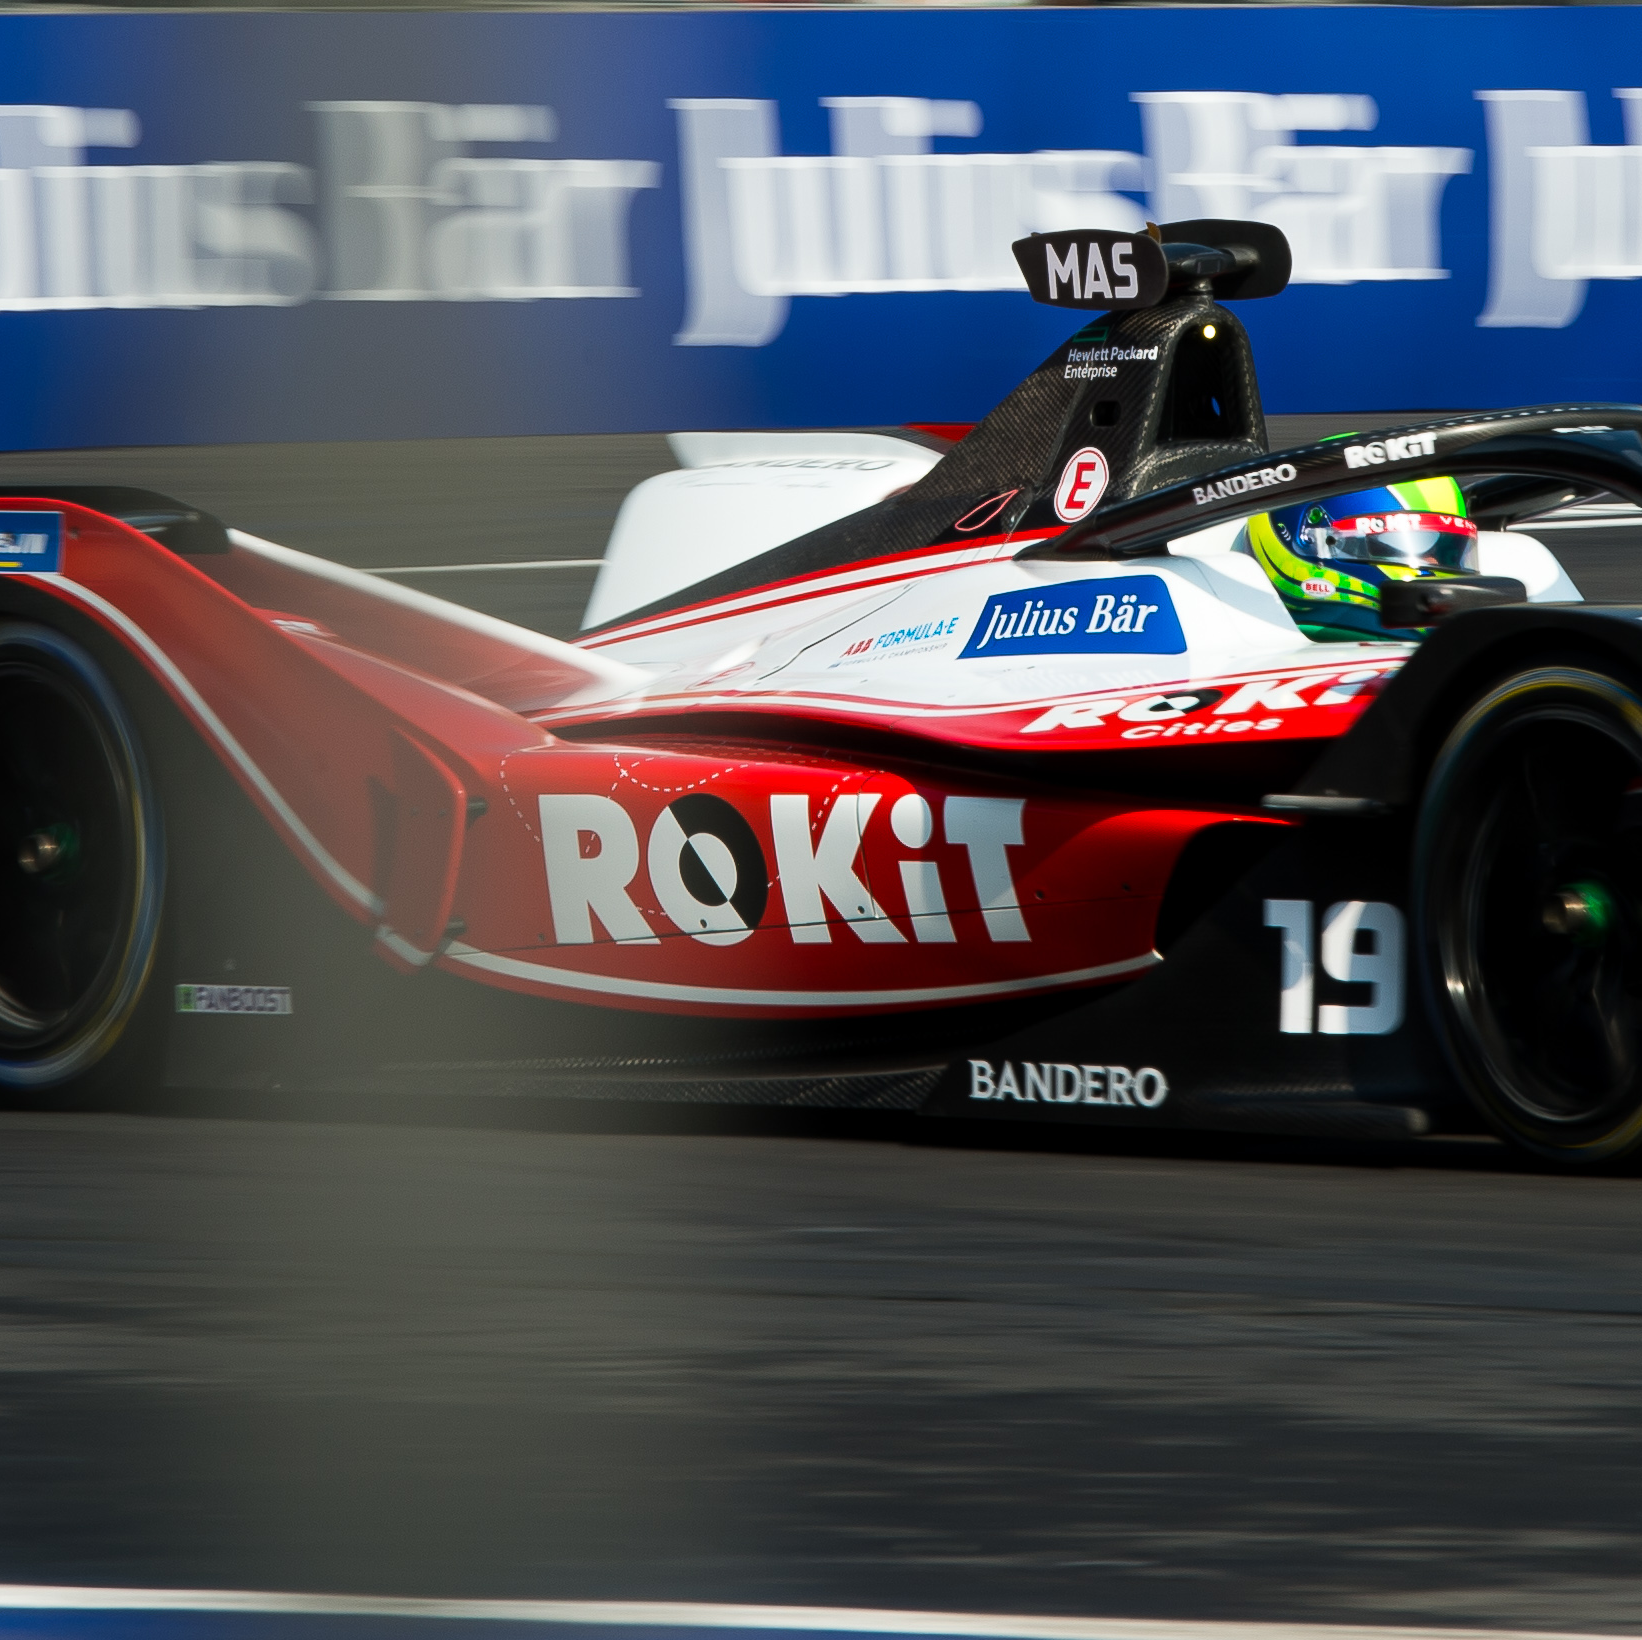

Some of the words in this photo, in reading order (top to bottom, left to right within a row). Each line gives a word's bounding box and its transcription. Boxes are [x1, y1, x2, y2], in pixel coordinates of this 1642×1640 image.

[304, 100, 659, 302] Bär
[666, 96, 1154, 347] Julius
[1130, 91, 1473, 284] Bär
[1045, 242, 1139, 299] MAS
[1063, 364, 1118, 381] Enterprise
[1067, 347, 1110, 363] Hewlett
[1110, 345, 1159, 361] Packard
[1343, 431, 1437, 469] ROKiT
[1064, 461, 1097, 510] E
[1192, 463, 1297, 506] BANDERO
[1305, 581, 1331, 593] BELL
[976, 599, 1079, 650] Julius
[1084, 594, 1158, 635] Bär
[838, 637, 874, 658] ABB
[1018, 666, 1387, 734] ROKi
[1121, 717, 1284, 740] Cities
[538, 792, 1032, 947] ROKiT
[1263, 898, 1407, 1036] 19
[968, 1059, 1170, 1108] BANDERO
